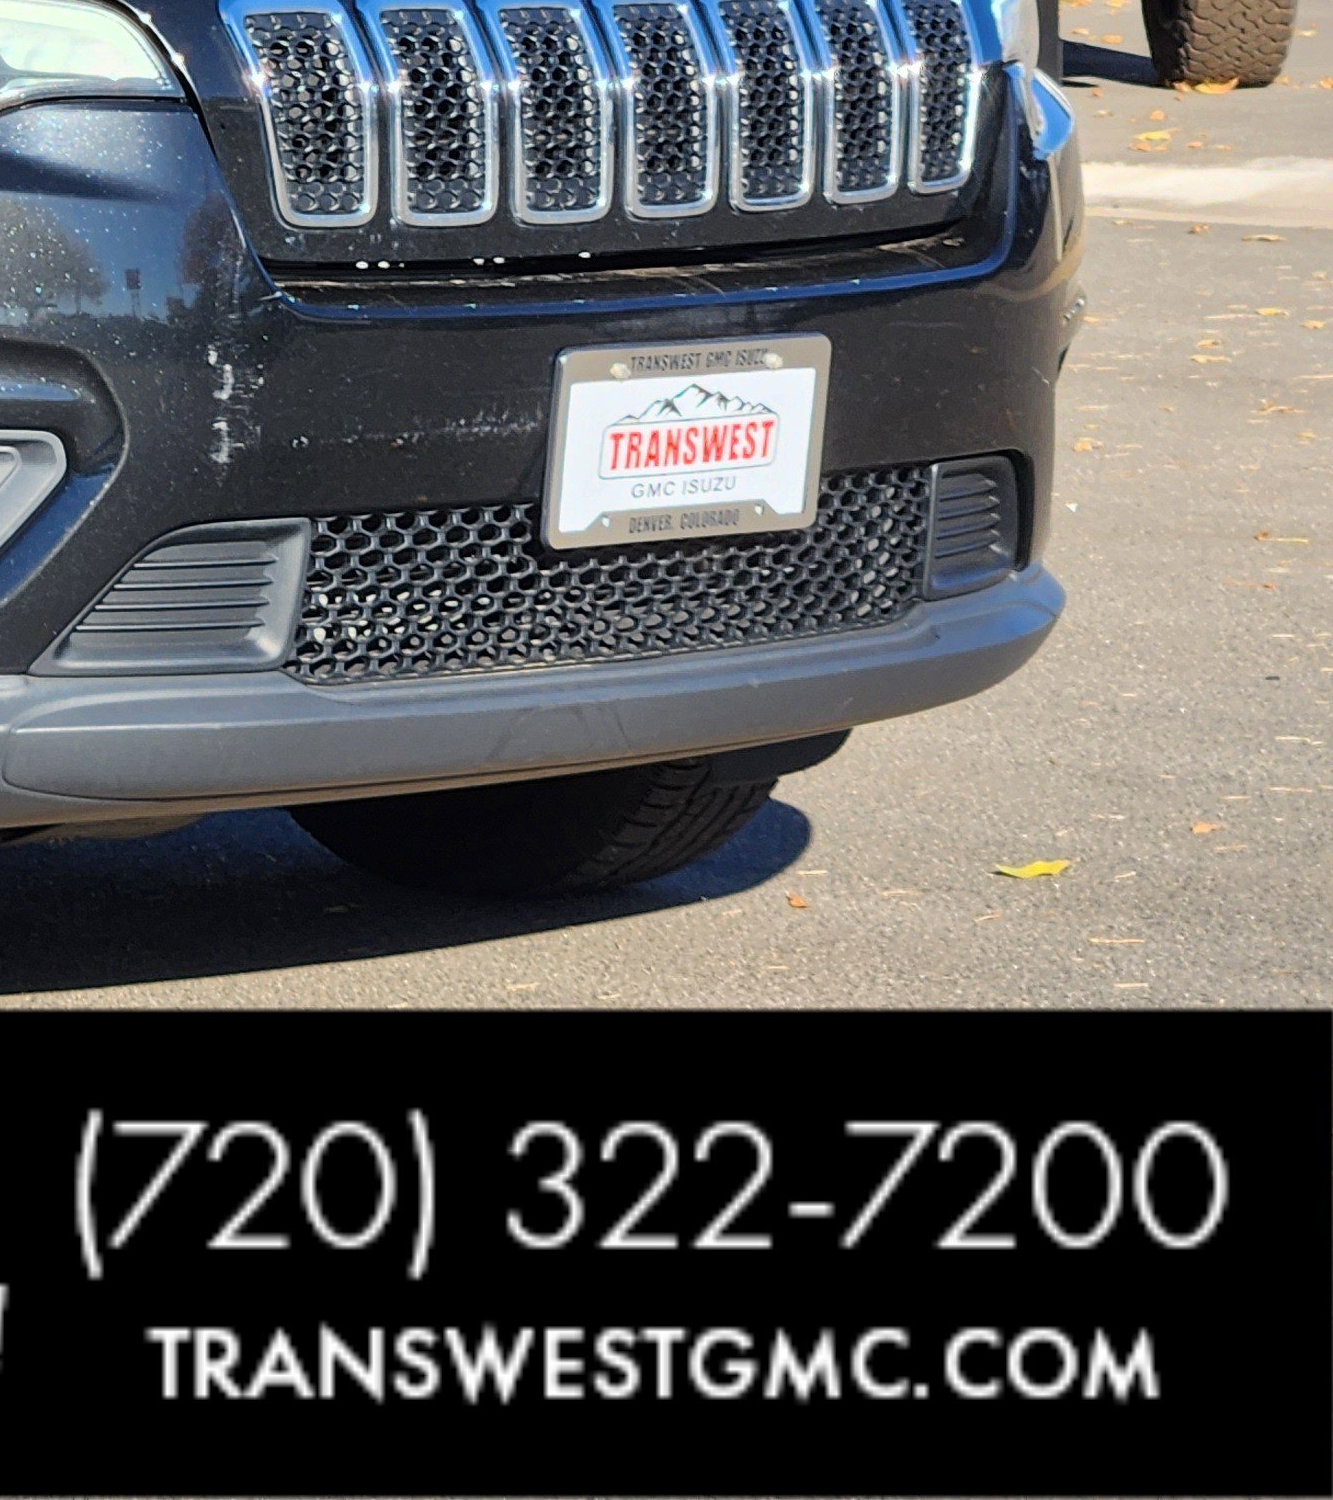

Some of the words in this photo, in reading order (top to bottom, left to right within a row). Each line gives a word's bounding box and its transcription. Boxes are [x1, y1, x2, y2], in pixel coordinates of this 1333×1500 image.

[631, 352, 701, 370] TRANSWEST
[706, 350, 733, 367] GMC
[609, 419, 775, 471] TRANSWEST
[631, 481, 676, 498] GMC
[682, 477, 737, 495] ISUZU
[680, 509, 741, 530] COLORADO
